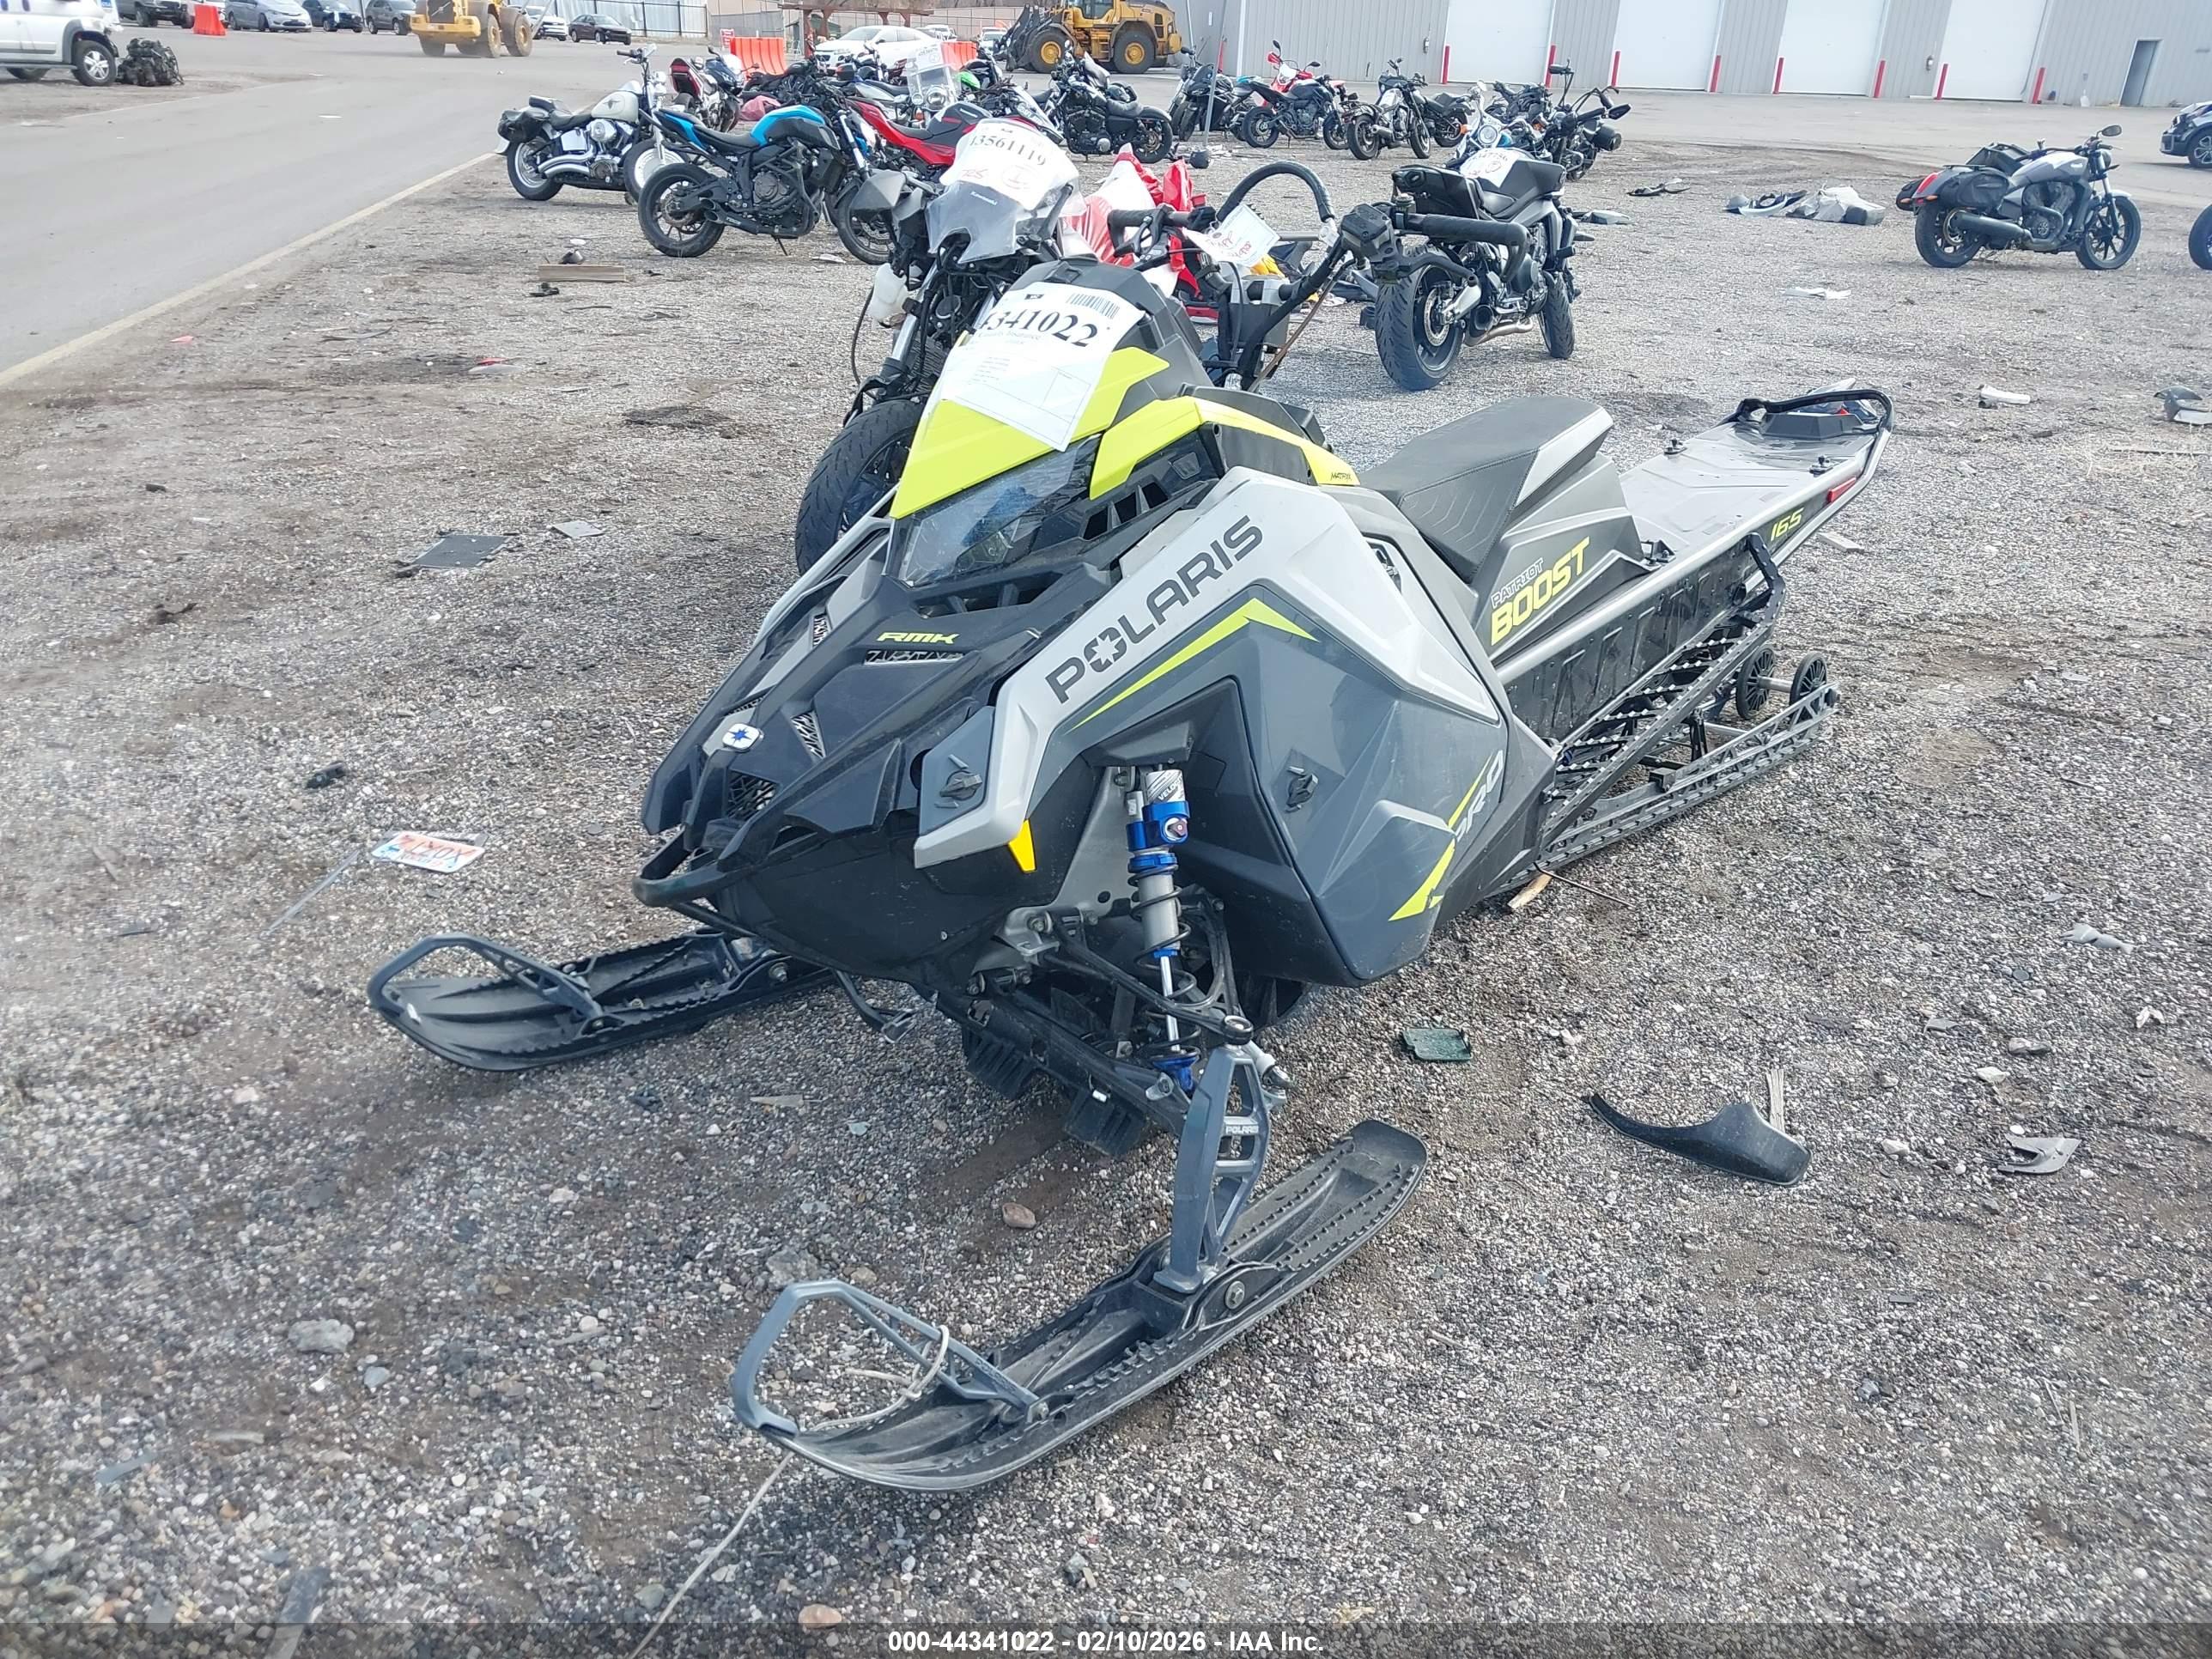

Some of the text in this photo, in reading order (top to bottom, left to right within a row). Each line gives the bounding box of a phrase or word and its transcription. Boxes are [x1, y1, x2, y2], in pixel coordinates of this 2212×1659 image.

[1770, 507, 1805, 542] 165
[1045, 515, 1263, 704] POLARIS
[1491, 556, 1544, 610] PATRIOT
[1491, 536, 1590, 646] BOOST
[876, 632, 960, 644] RMK
